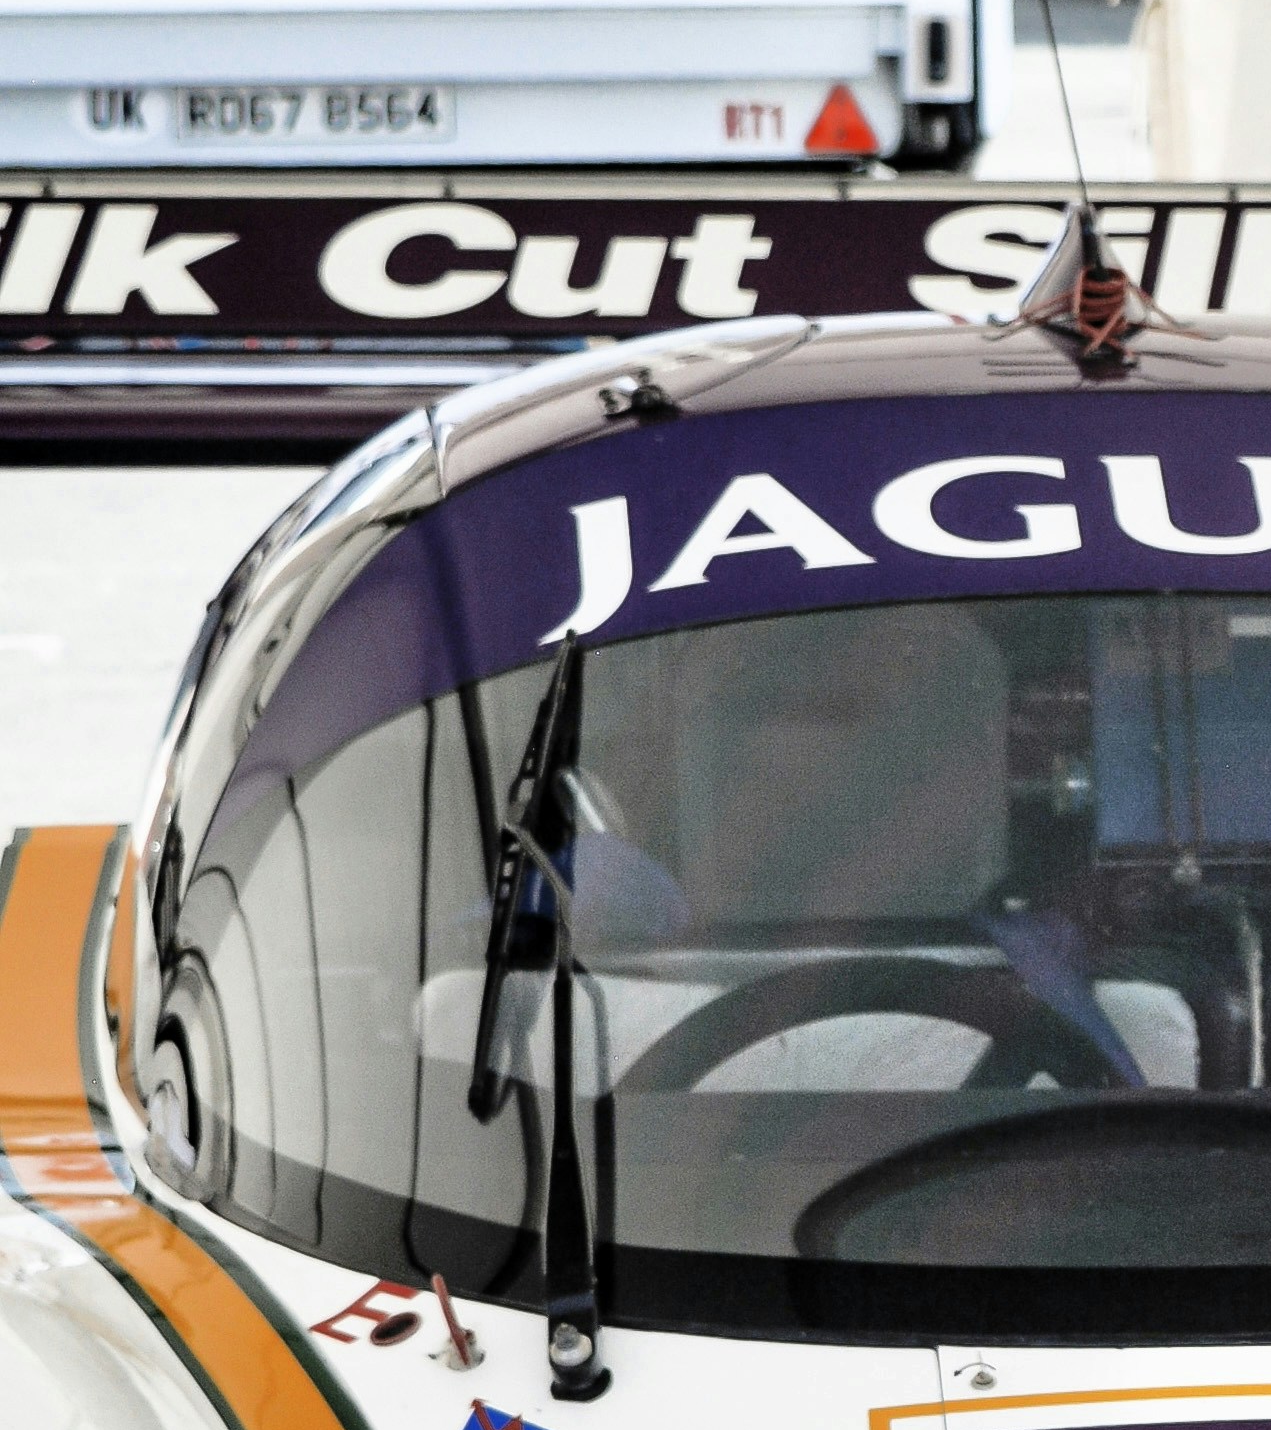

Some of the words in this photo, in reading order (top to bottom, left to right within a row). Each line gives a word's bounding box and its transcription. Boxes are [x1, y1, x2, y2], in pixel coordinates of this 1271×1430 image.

[90, 89, 144, 131] UK
[0, 202, 241, 316] lk
[318, 202, 773, 320] Cut
